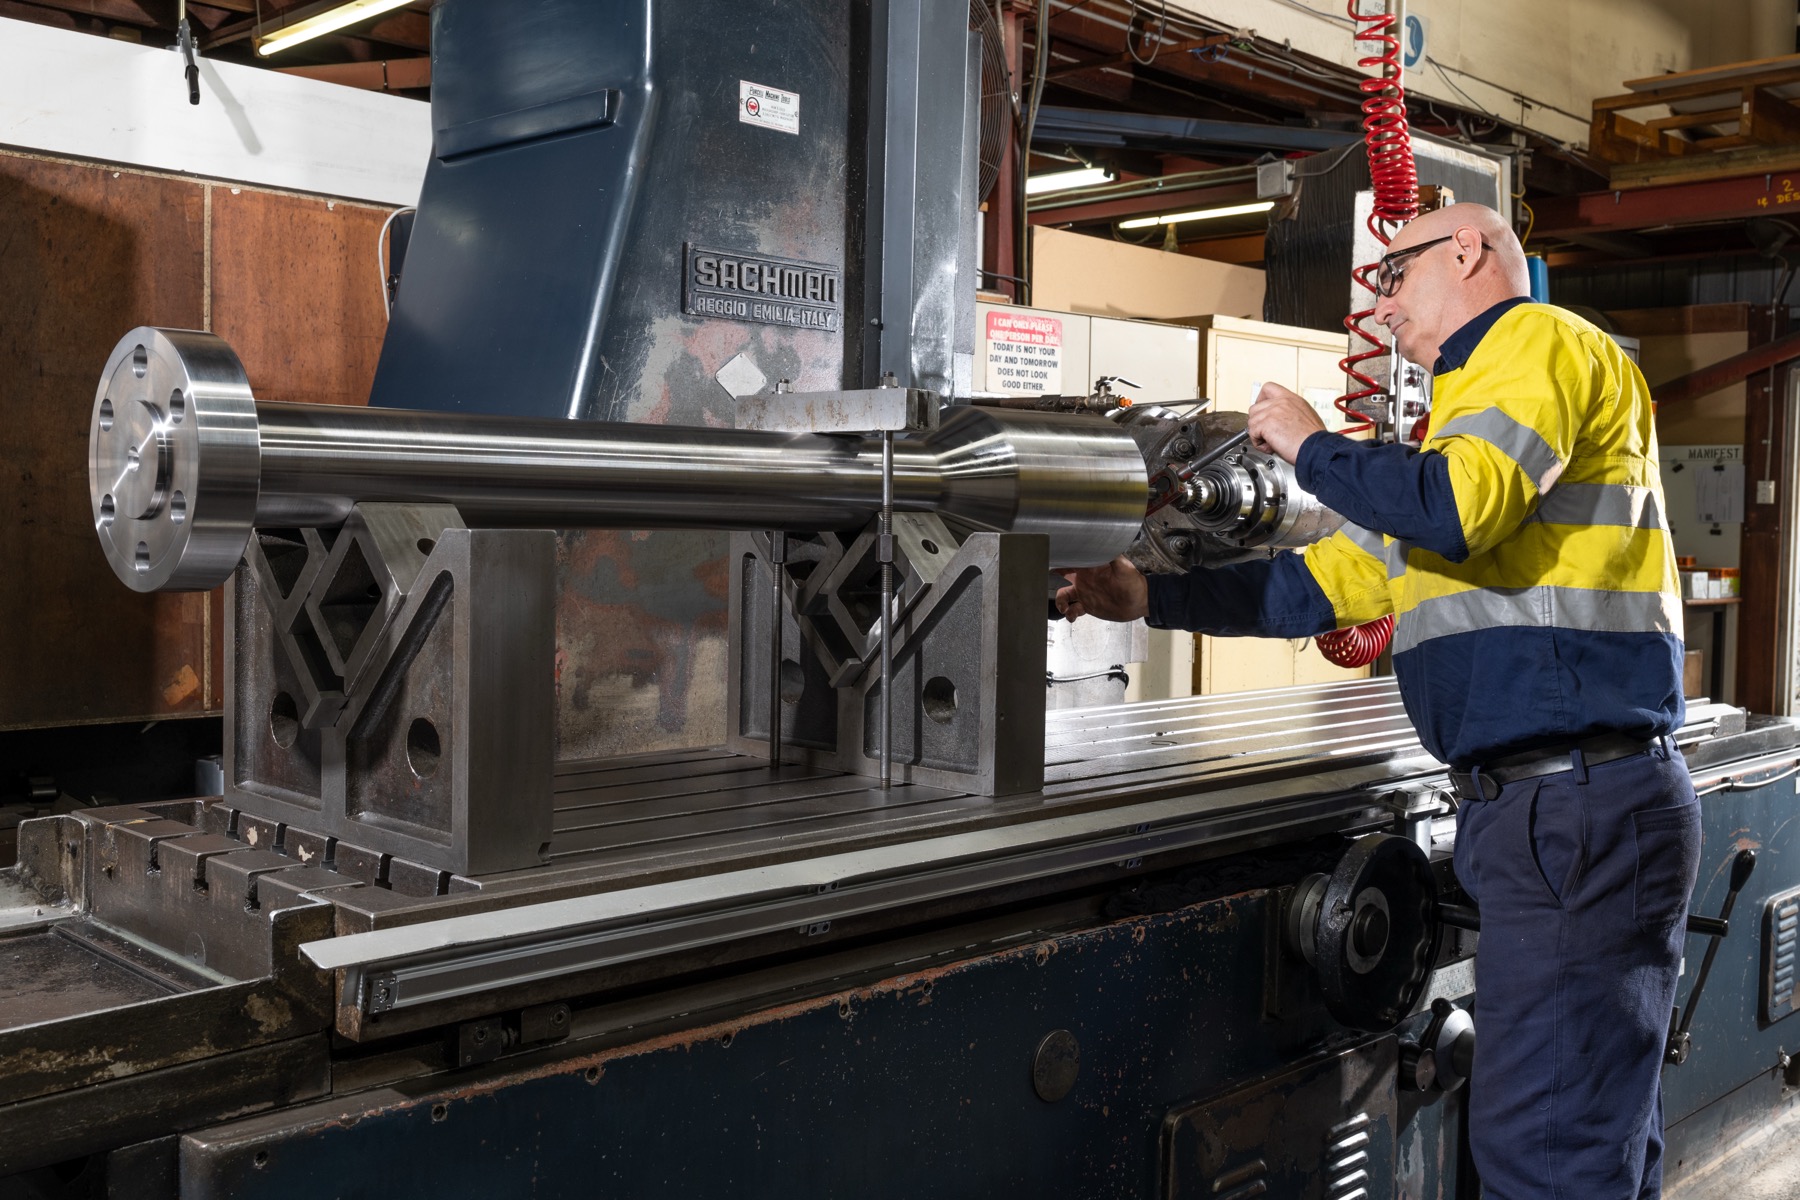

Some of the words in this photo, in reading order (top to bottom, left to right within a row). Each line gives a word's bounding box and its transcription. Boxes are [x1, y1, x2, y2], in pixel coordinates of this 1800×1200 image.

[1375, 47, 1384, 55] AR
[1782, 179, 1794, 192] 2
[695, 256, 838, 303] SACHMAN
[697, 296, 746, 317] REGGIO
[998, 318, 1012, 328] CAN
[1012, 320, 1030, 330] ONLY
[1030, 322, 1053, 332] PLEASE
[1005, 331, 1030, 342] PERSON
[1031, 334, 1044, 343] PER
[993, 342, 1014, 352] TODAY
[1016, 345, 1022, 353] IS
[1023, 345, 1037, 354] NOT
[1038, 347, 1056, 356] YOUR
[989, 354, 1002, 363] DAY
[1004, 356, 1018, 365] AND
[1020, 357, 1059, 368] TOMORROW
[997, 367, 1014, 376] DOES
[1015, 369, 1029, 378] NOT
[1030, 371, 1048, 379] LOOK
[1002, 380, 1021, 389] GOOD
[1022, 382, 1046, 391] EITHER.
[1688, 447, 1740, 460] MANIFEST
